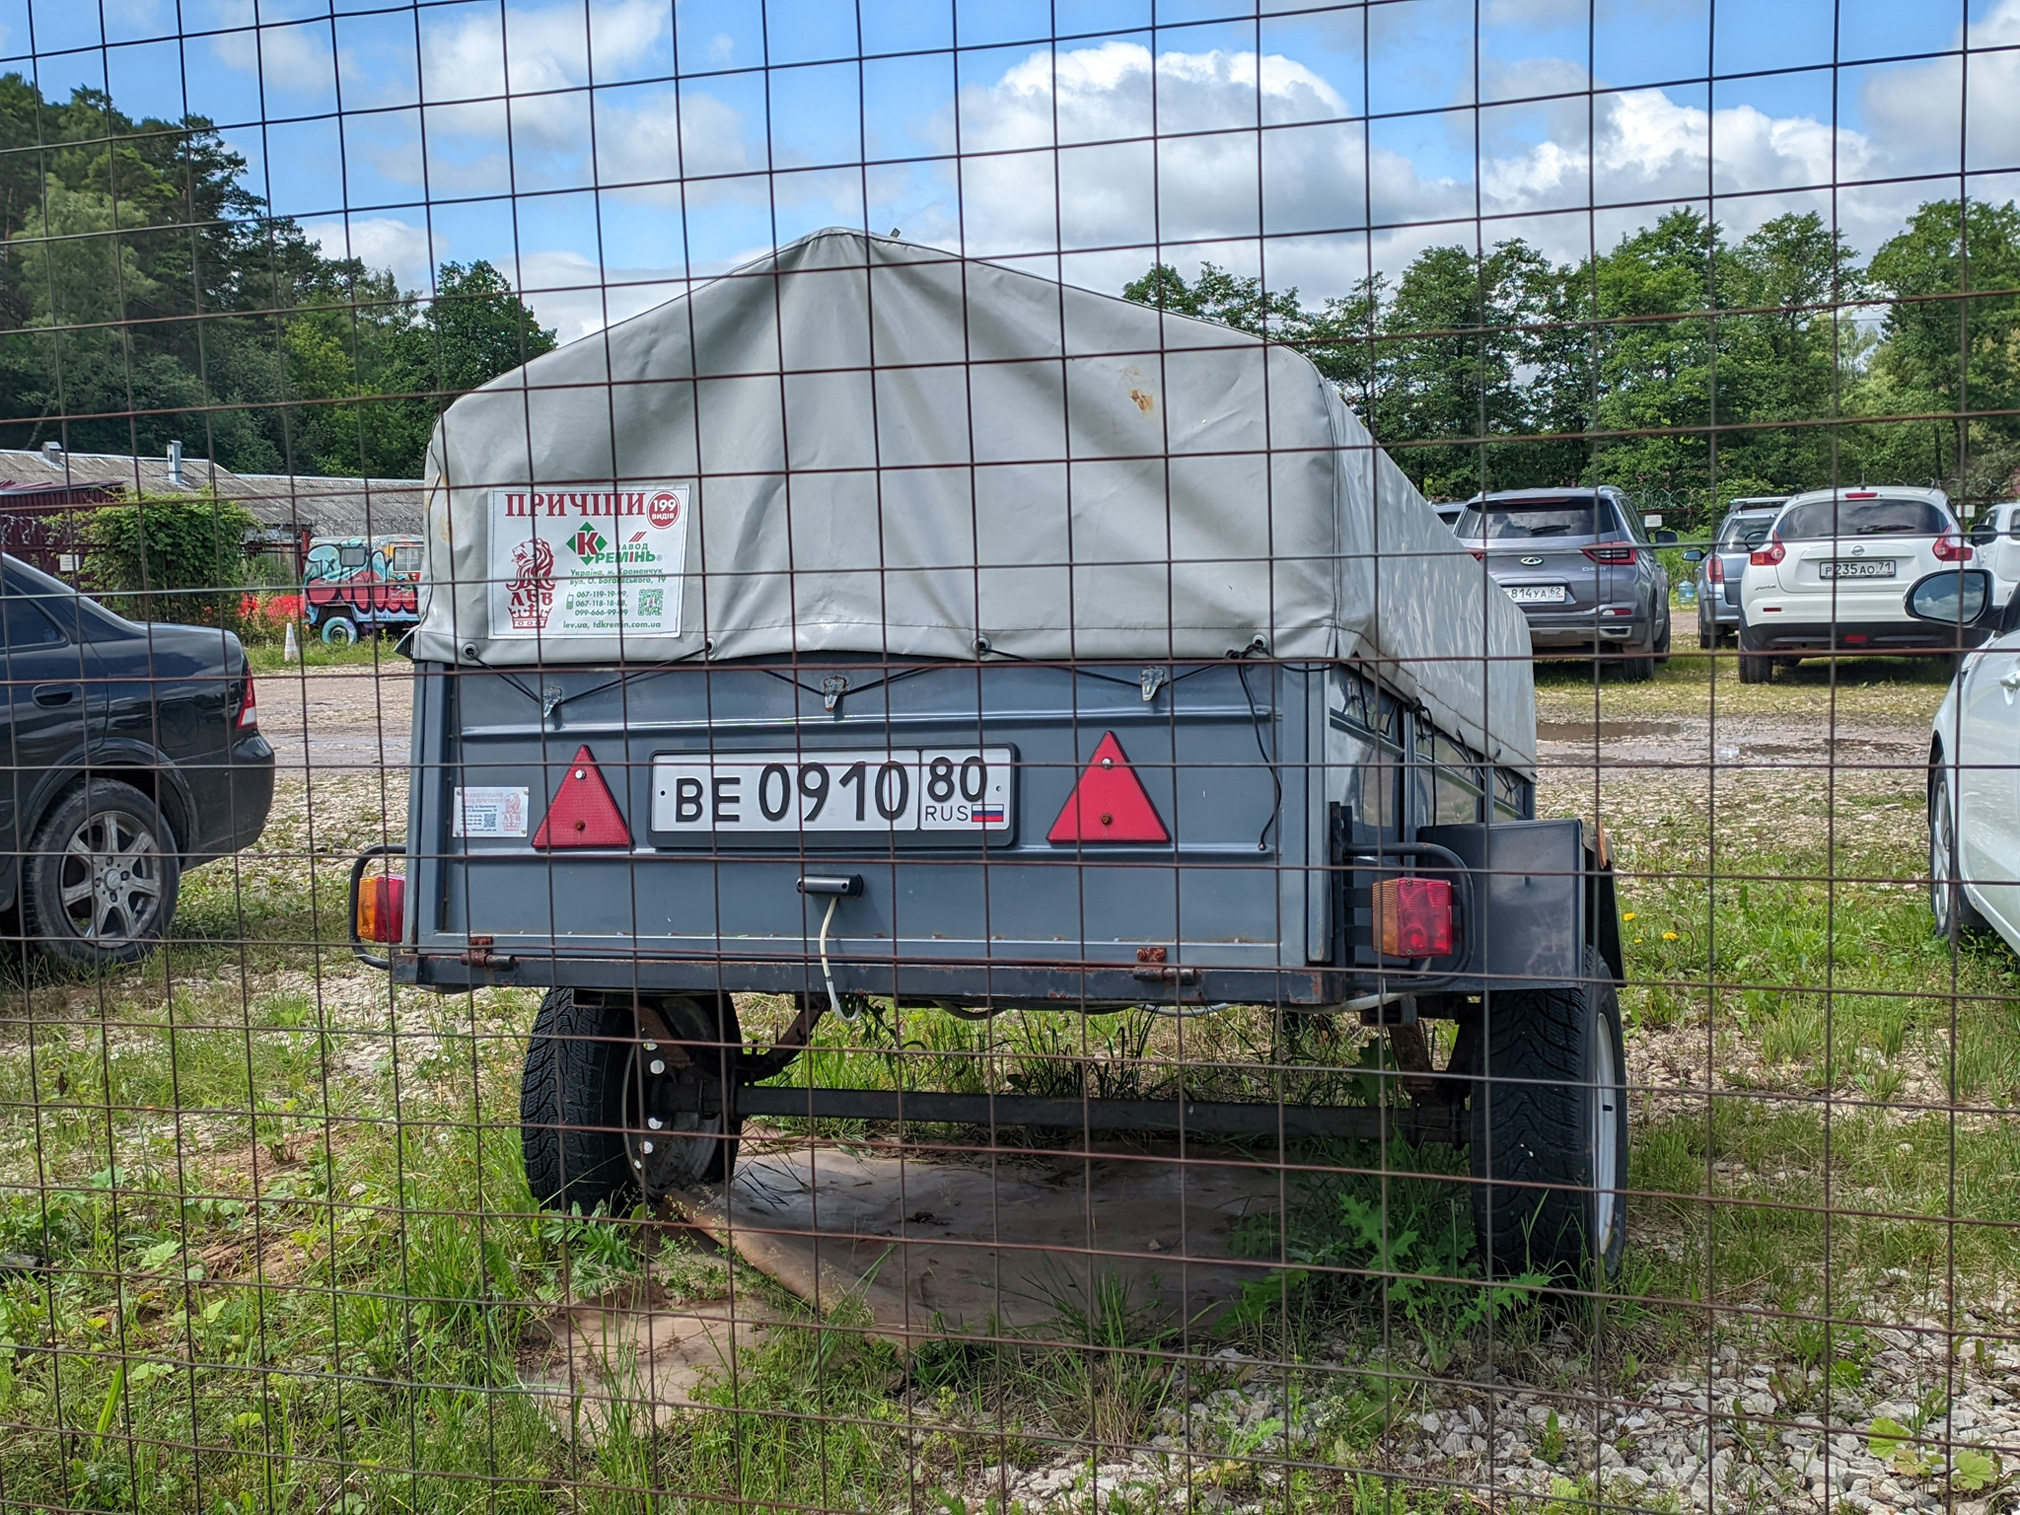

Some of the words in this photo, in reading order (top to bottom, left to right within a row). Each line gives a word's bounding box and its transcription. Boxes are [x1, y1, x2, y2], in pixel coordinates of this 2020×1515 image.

[505, 492, 646, 517] ПРИЧІПИ
[653, 499, 677, 512] 199
[1878, 562, 1891, 571] 71
[598, 577, 654, 585] Богавського,
[576, 590, 629, 598] 067-119-19-9,
[1506, 588, 1547, 599] 814УА
[1549, 587, 1562, 596] 62
[593, 620, 661, 629] tdkremn.com.ua
[675, 776, 741, 823] ВЕ
[758, 760, 910, 822] 0910
[927, 755, 988, 803] 80
[924, 804, 969, 822] RUS
